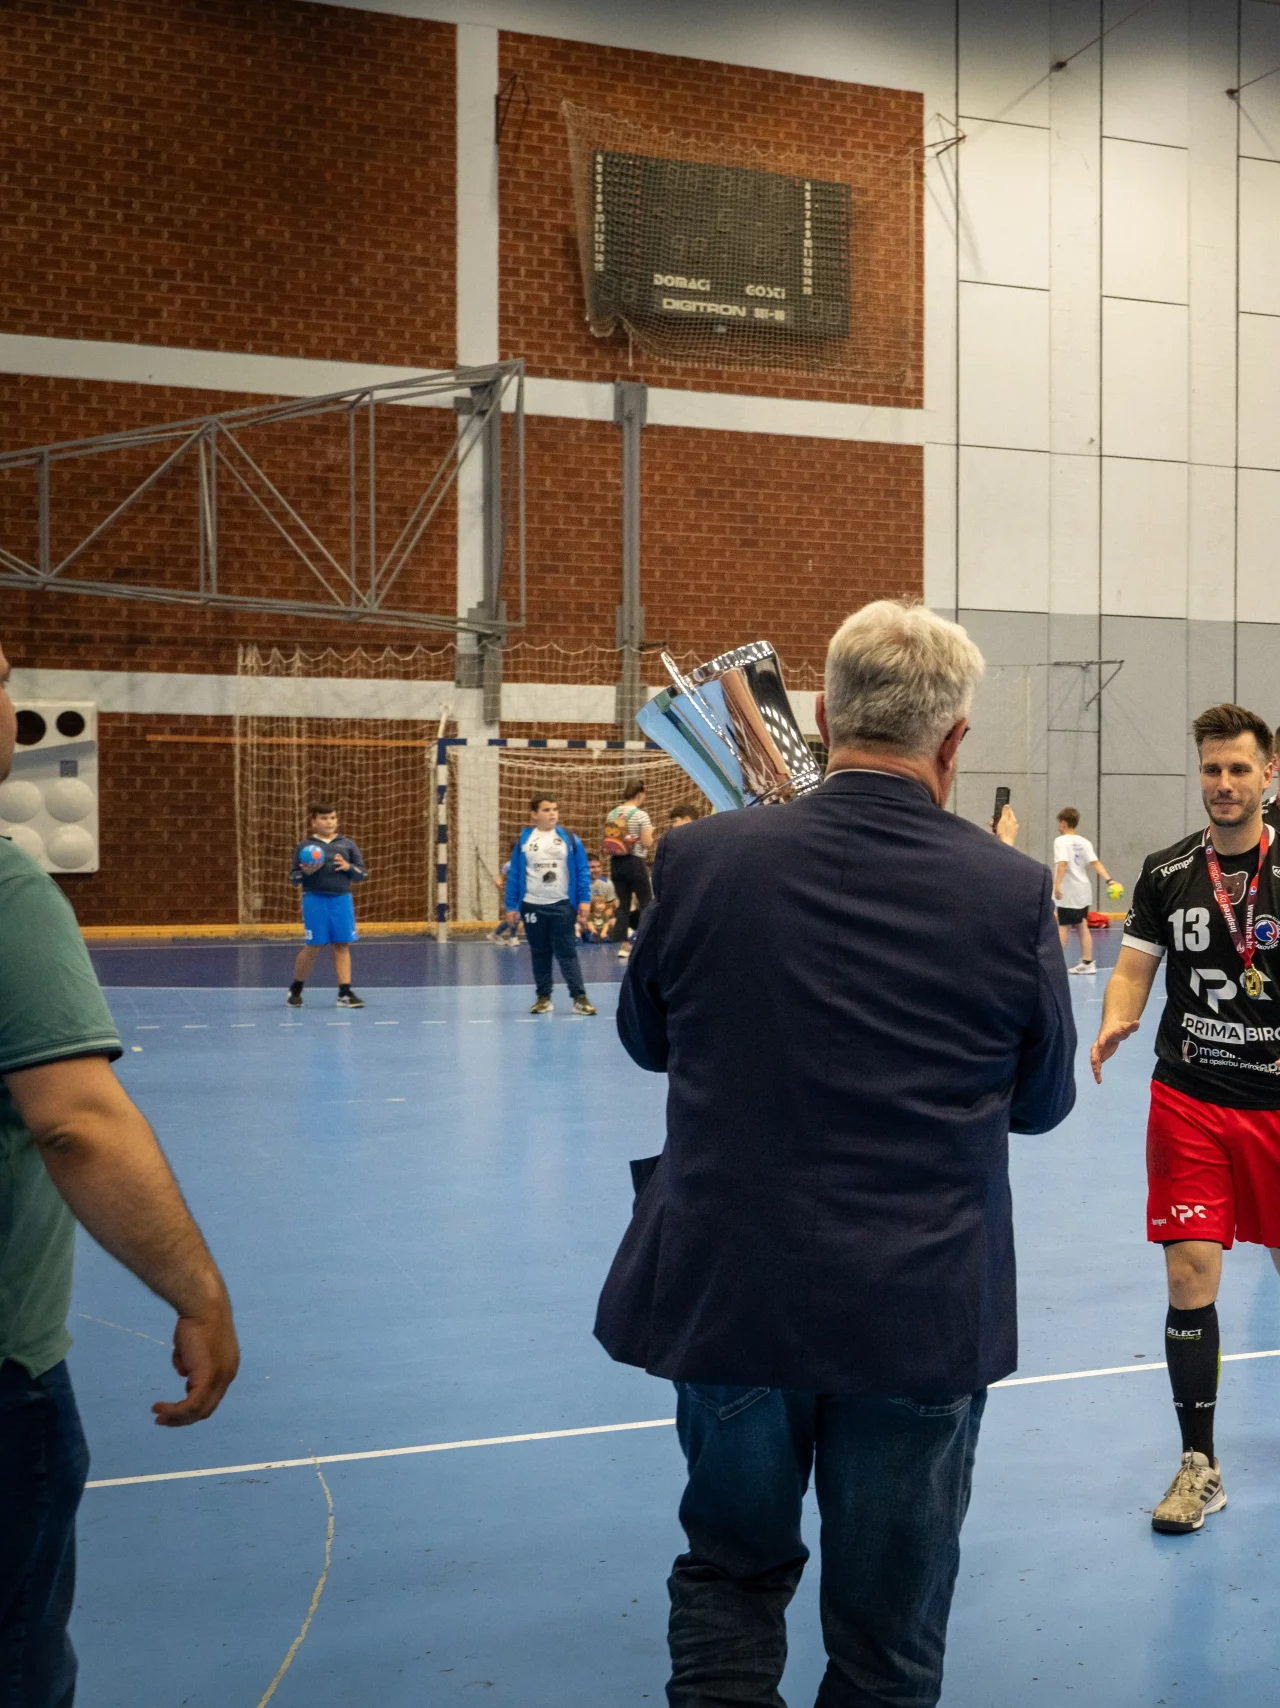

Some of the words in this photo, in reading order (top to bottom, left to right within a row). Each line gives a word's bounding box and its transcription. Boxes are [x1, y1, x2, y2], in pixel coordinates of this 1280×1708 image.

[663, 298, 746, 317] DIGITRON
[524, 912, 537, 923] 16
[1168, 907, 1210, 952] 13
[1185, 1017, 1242, 1041] PRIMA
[1167, 1327, 1203, 1338] SELECT
